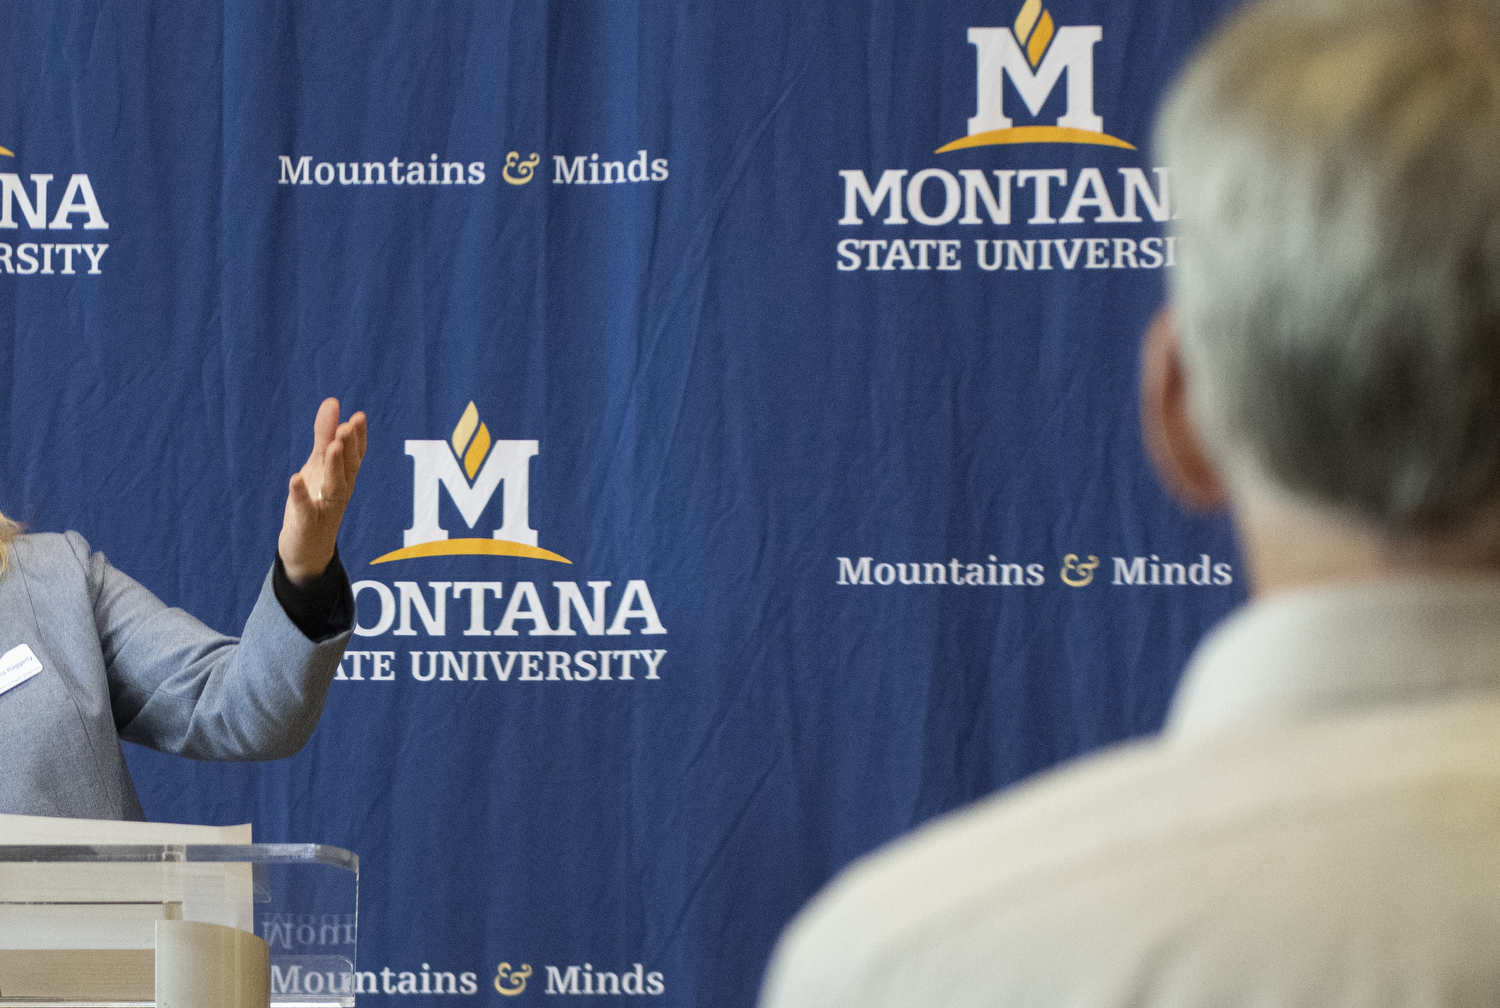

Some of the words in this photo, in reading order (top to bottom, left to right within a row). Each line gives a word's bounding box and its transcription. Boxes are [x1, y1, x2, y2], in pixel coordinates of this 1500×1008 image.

[967, 25, 1104, 135] M
[279, 154, 485, 185] Mountains
[503, 152, 540, 185] &
[554, 150, 668, 184] Minds
[838, 166, 1182, 227] MONTAN
[838, 239, 961, 271] STATE
[975, 237, 1178, 270] UNIVERSI
[403, 439, 539, 548] M
[838, 555, 1044, 585] Mountains
[1061, 554, 1098, 587] &
[1113, 554, 1232, 585] Minds
[351, 580, 667, 636] ONTANA
[7, 656, 33, 673] Haggerty
[410, 649, 666, 681] UNIVERSITY
[271, 962, 478, 996] Mountains
[494, 962, 531, 996] &
[546, 964, 664, 994] Minds
